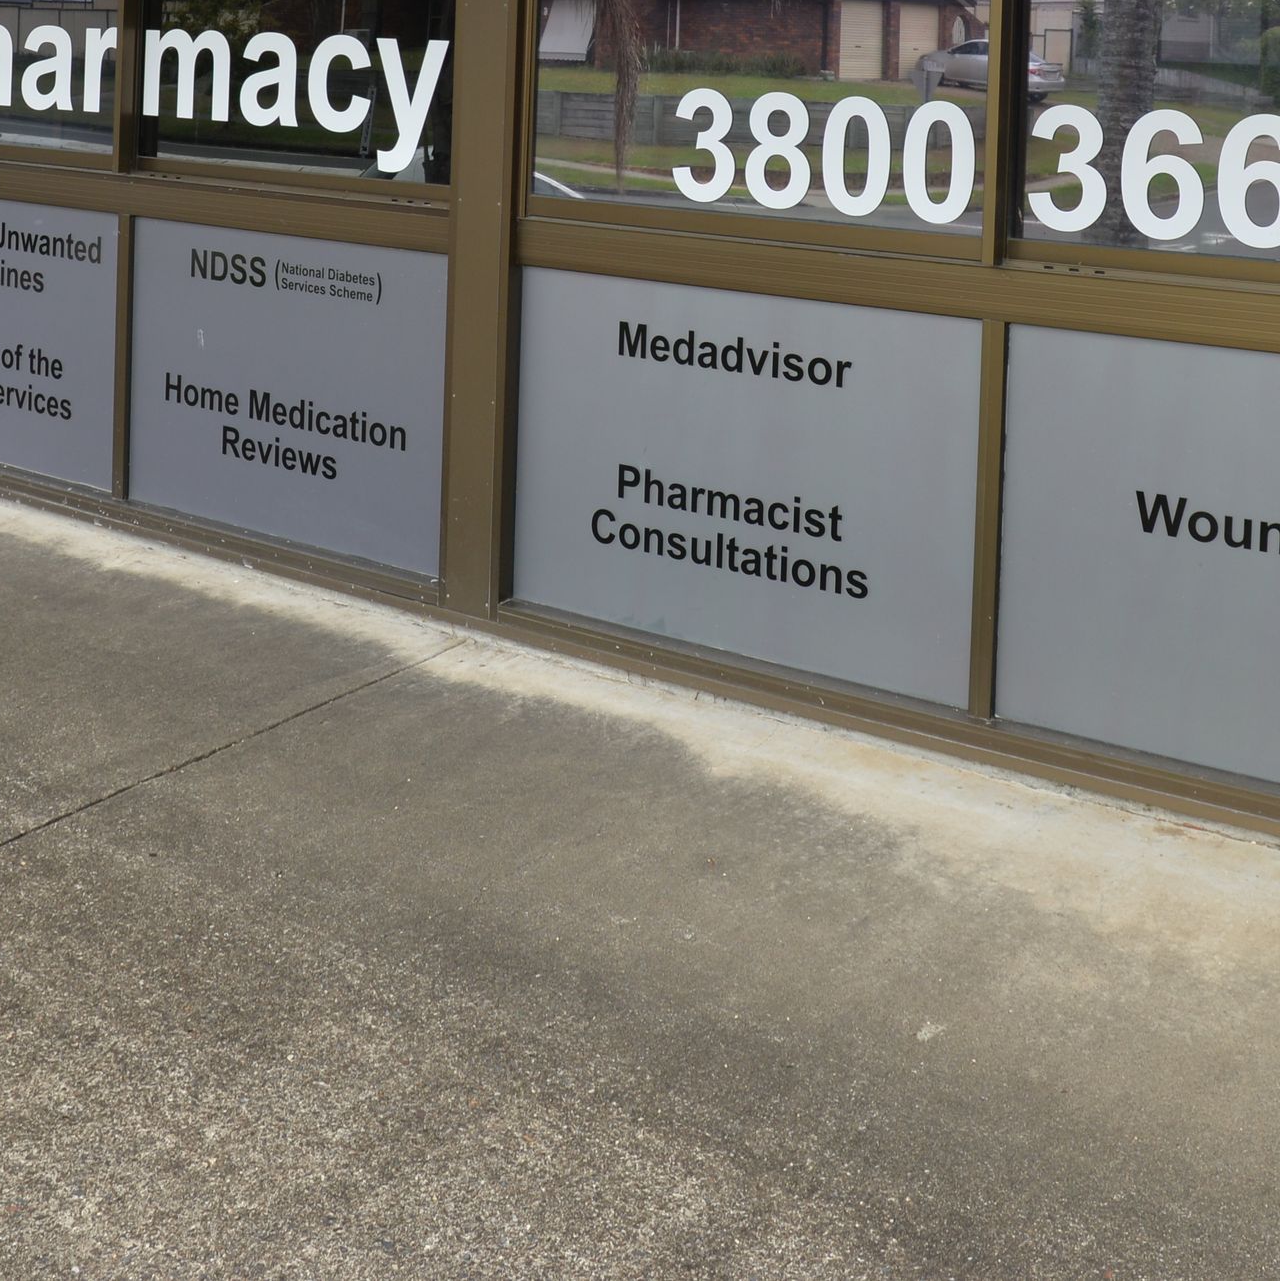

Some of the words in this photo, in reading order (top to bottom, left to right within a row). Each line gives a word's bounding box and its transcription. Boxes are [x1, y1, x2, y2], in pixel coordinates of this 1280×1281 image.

[672, 87, 976, 226] 3800
[190, 248, 267, 288] NDSS
[328, 268, 375, 286] Diabetes
[281, 277, 326, 295] Services
[1, 344, 23, 371] of
[28, 348, 63, 380] the
[617, 320, 854, 389] Medadvisor
[164, 372, 240, 416] Home
[248, 390, 407, 452] Medication
[221, 425, 339, 481] Reviews
[615, 463, 843, 544] Pharmacist
[590, 507, 870, 601] Consultations
